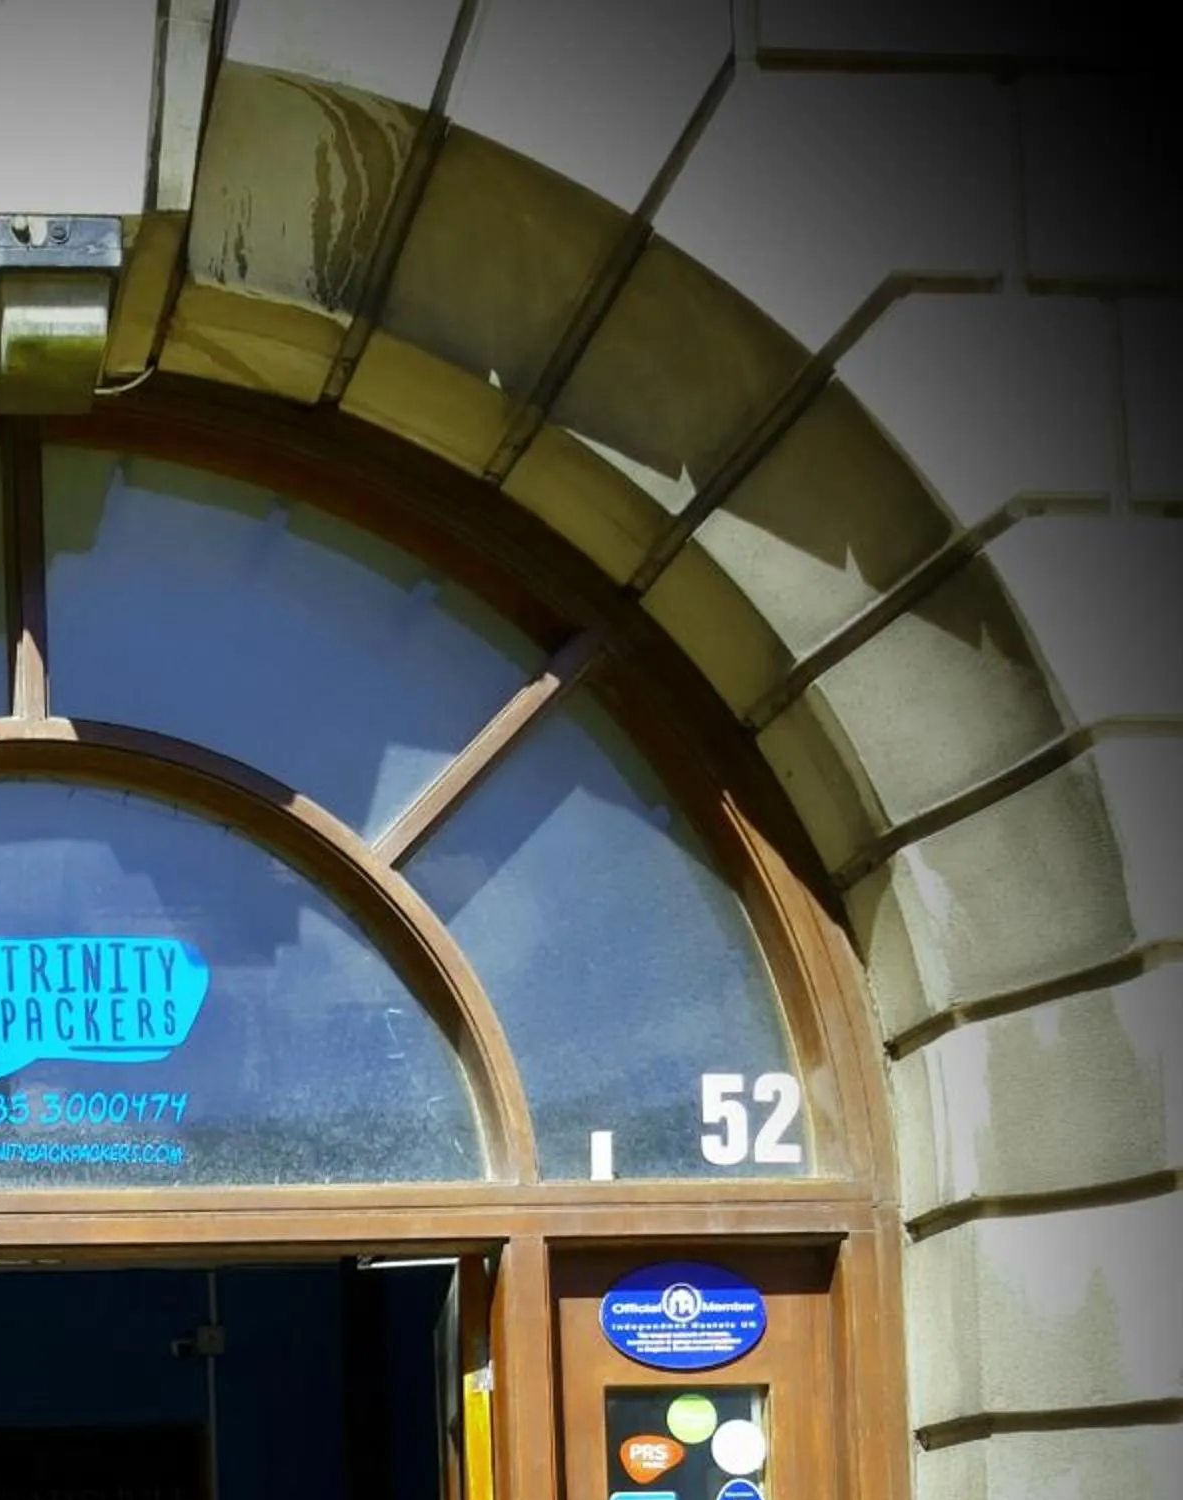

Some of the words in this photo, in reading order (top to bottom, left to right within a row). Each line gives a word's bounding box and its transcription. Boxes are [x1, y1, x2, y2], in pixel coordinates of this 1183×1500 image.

[1, 942, 178, 994] TRINITY
[38, 1092, 188, 1124] 3000474
[700, 1072, 802, 1166] 52
